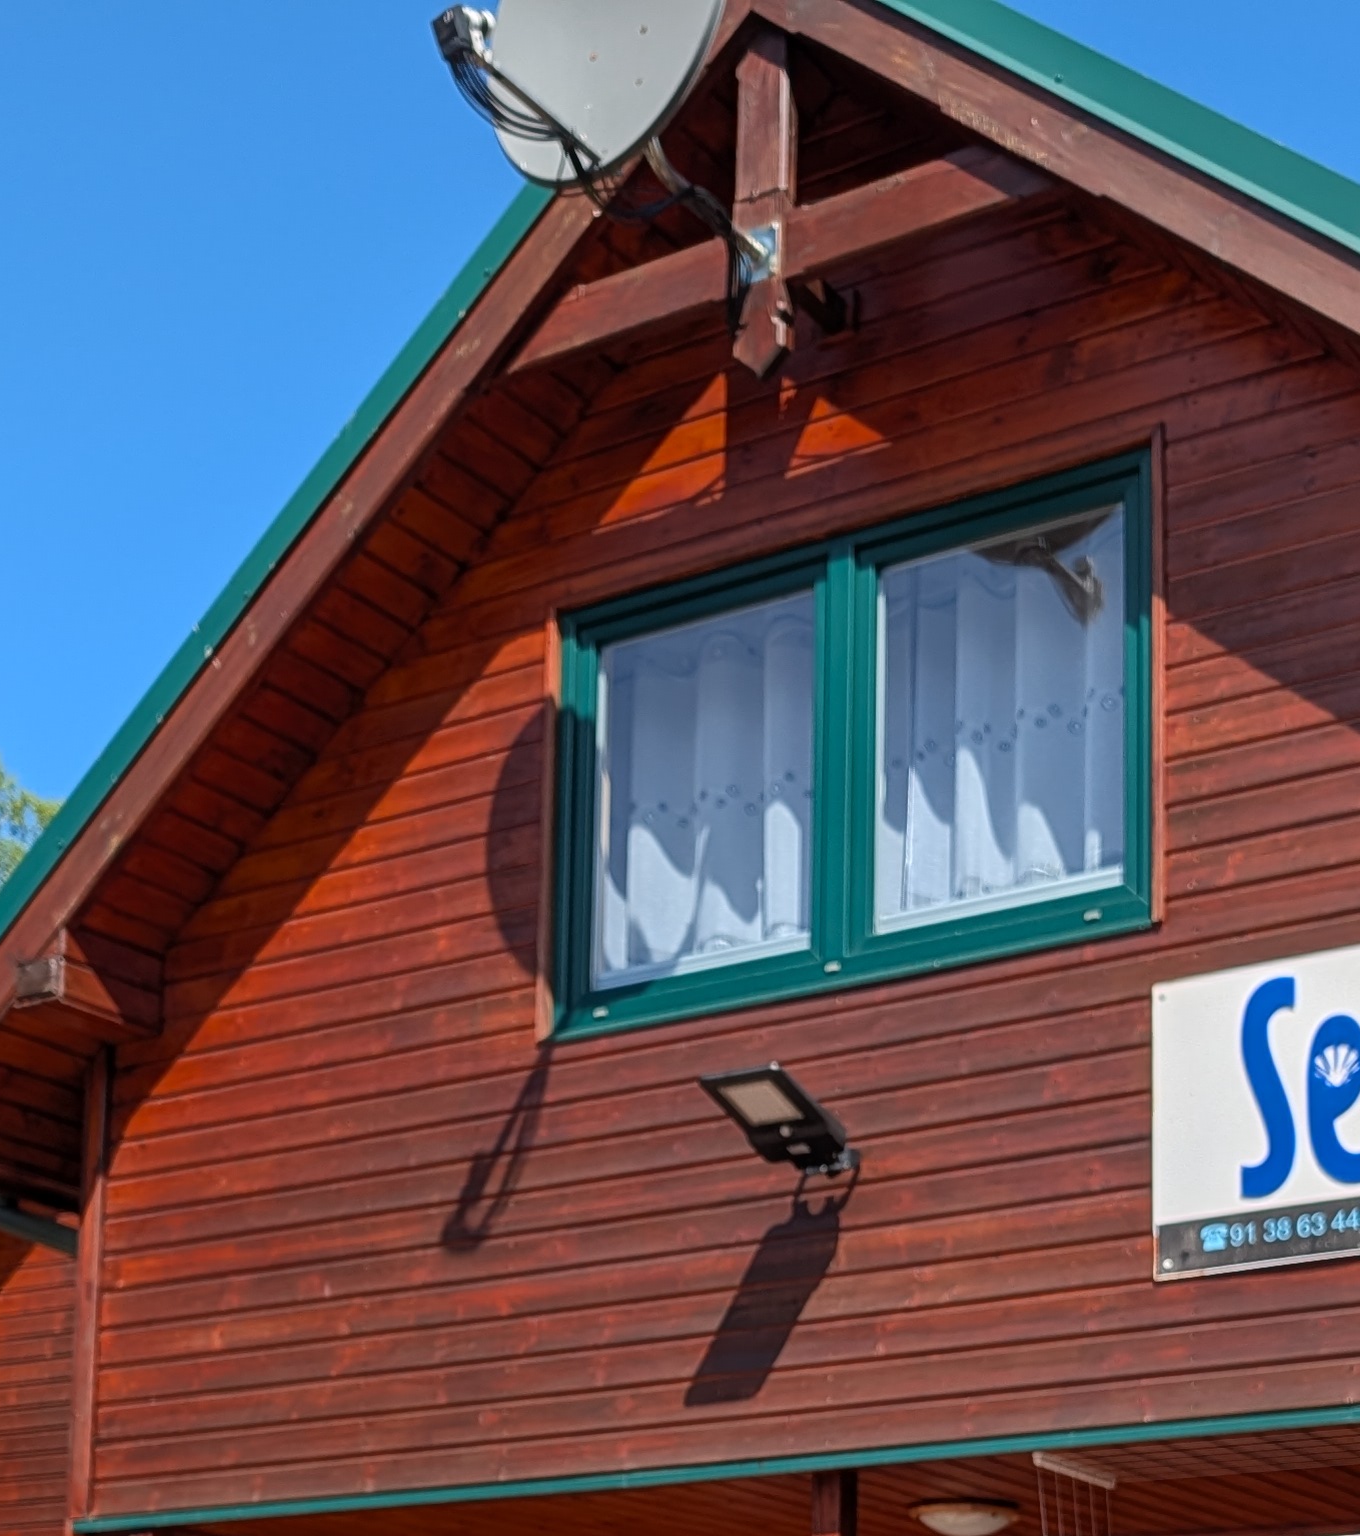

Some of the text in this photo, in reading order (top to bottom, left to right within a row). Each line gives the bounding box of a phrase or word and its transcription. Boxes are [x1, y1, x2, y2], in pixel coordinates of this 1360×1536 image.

[1230, 1221, 1256, 1247] 91
[1263, 1217, 1291, 1242] 38
[1296, 1211, 1328, 1238] 63
